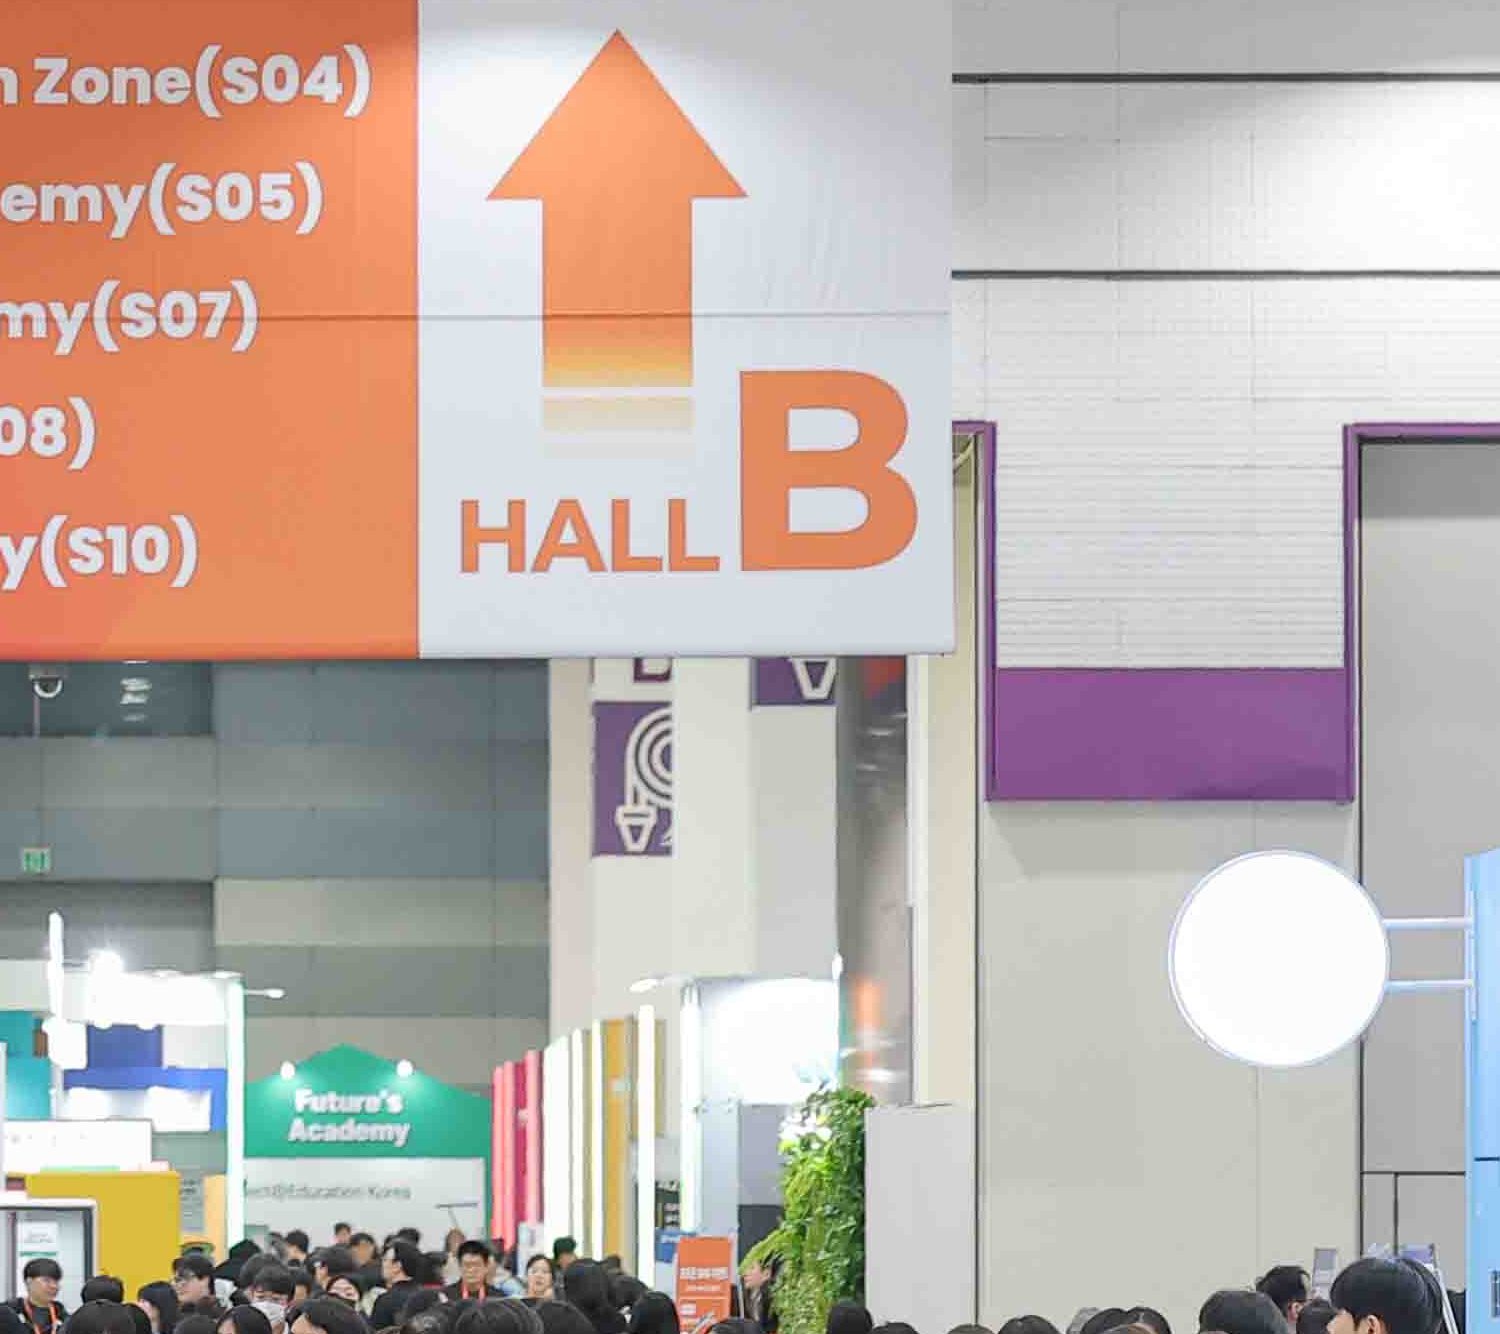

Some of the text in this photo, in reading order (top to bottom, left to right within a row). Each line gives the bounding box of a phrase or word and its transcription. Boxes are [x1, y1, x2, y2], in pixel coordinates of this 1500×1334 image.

[34, 44, 373, 118] Zone(S04)
[462, 370, 917, 572] HALL B
[288, 1119, 411, 1147] Academy
